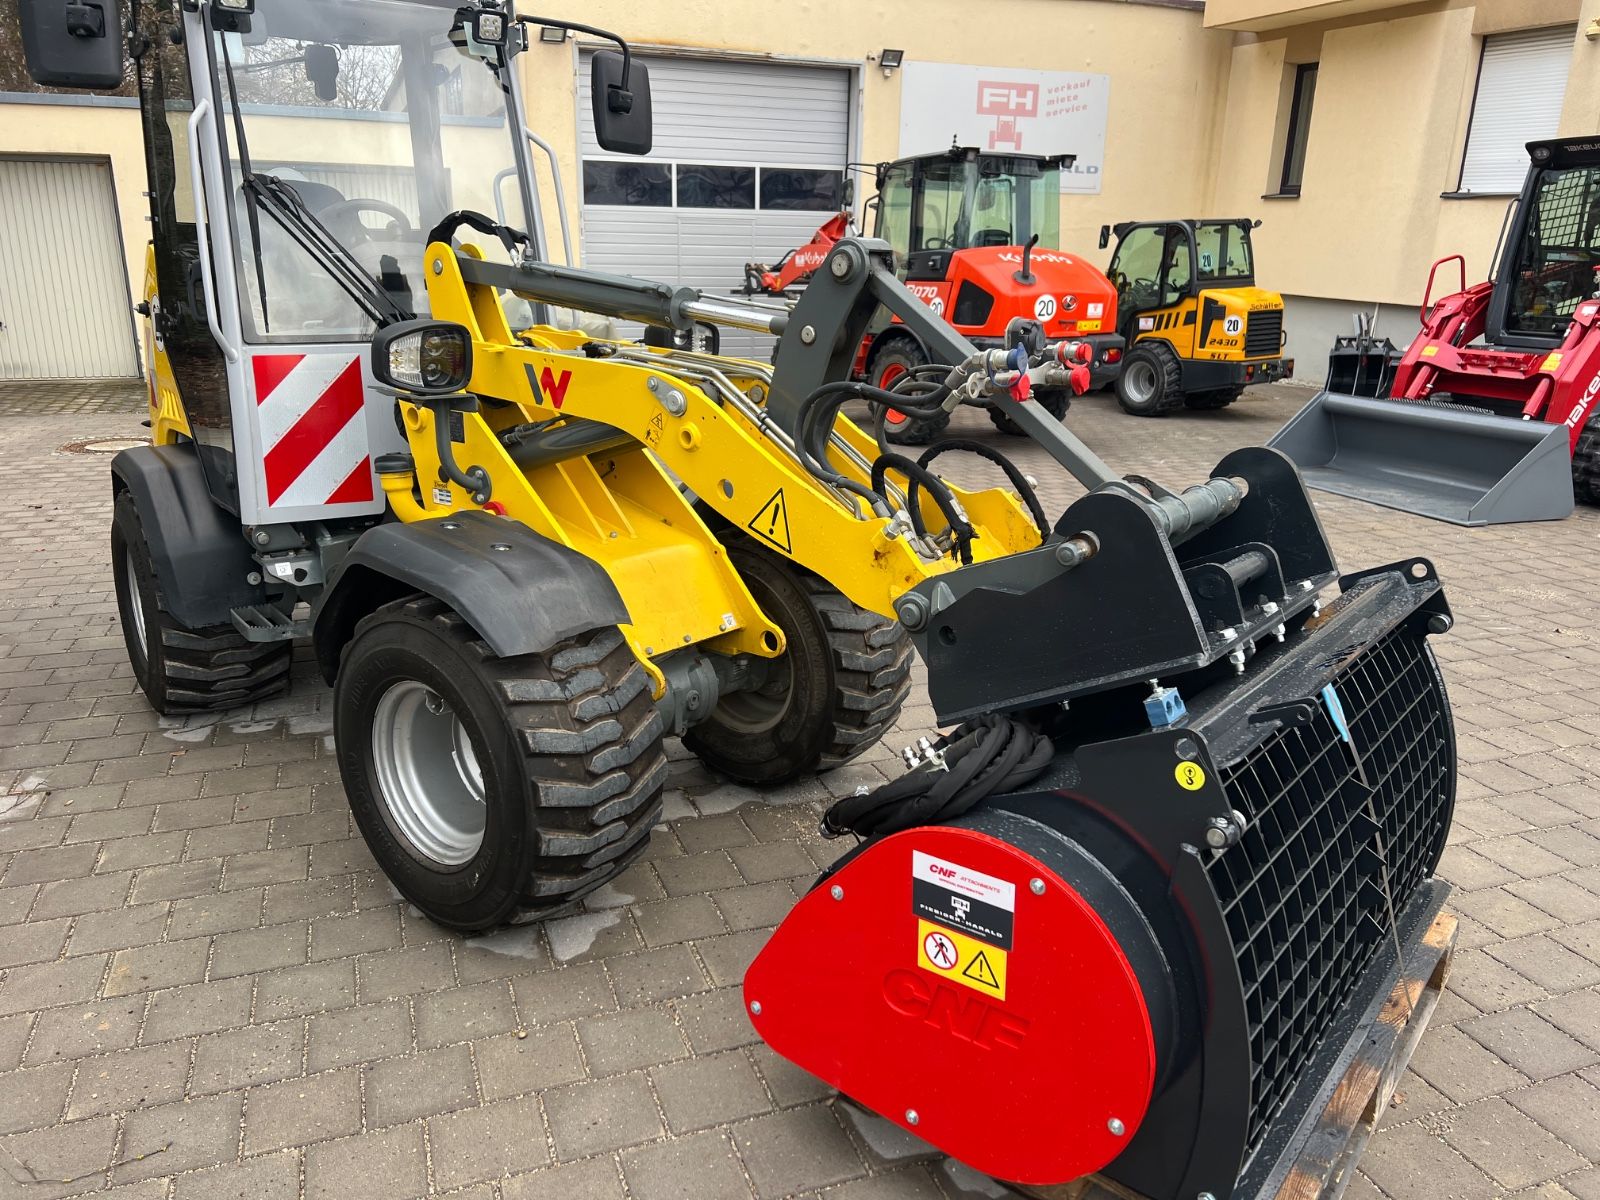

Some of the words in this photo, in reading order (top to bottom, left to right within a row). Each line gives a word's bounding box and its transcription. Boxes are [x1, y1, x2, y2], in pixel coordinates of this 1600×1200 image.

[982, 87, 1034, 111] FH
[1202, 254, 1213, 268] 20
[1037, 300, 1054, 316] 20
[1226, 319, 1239, 332] 20
[1209, 338, 1238, 346] 2430
[929, 864, 957, 879] CNF
[960, 876, 1001, 894] ATTACHMENTS
[883, 968, 1031, 1050] CNF
